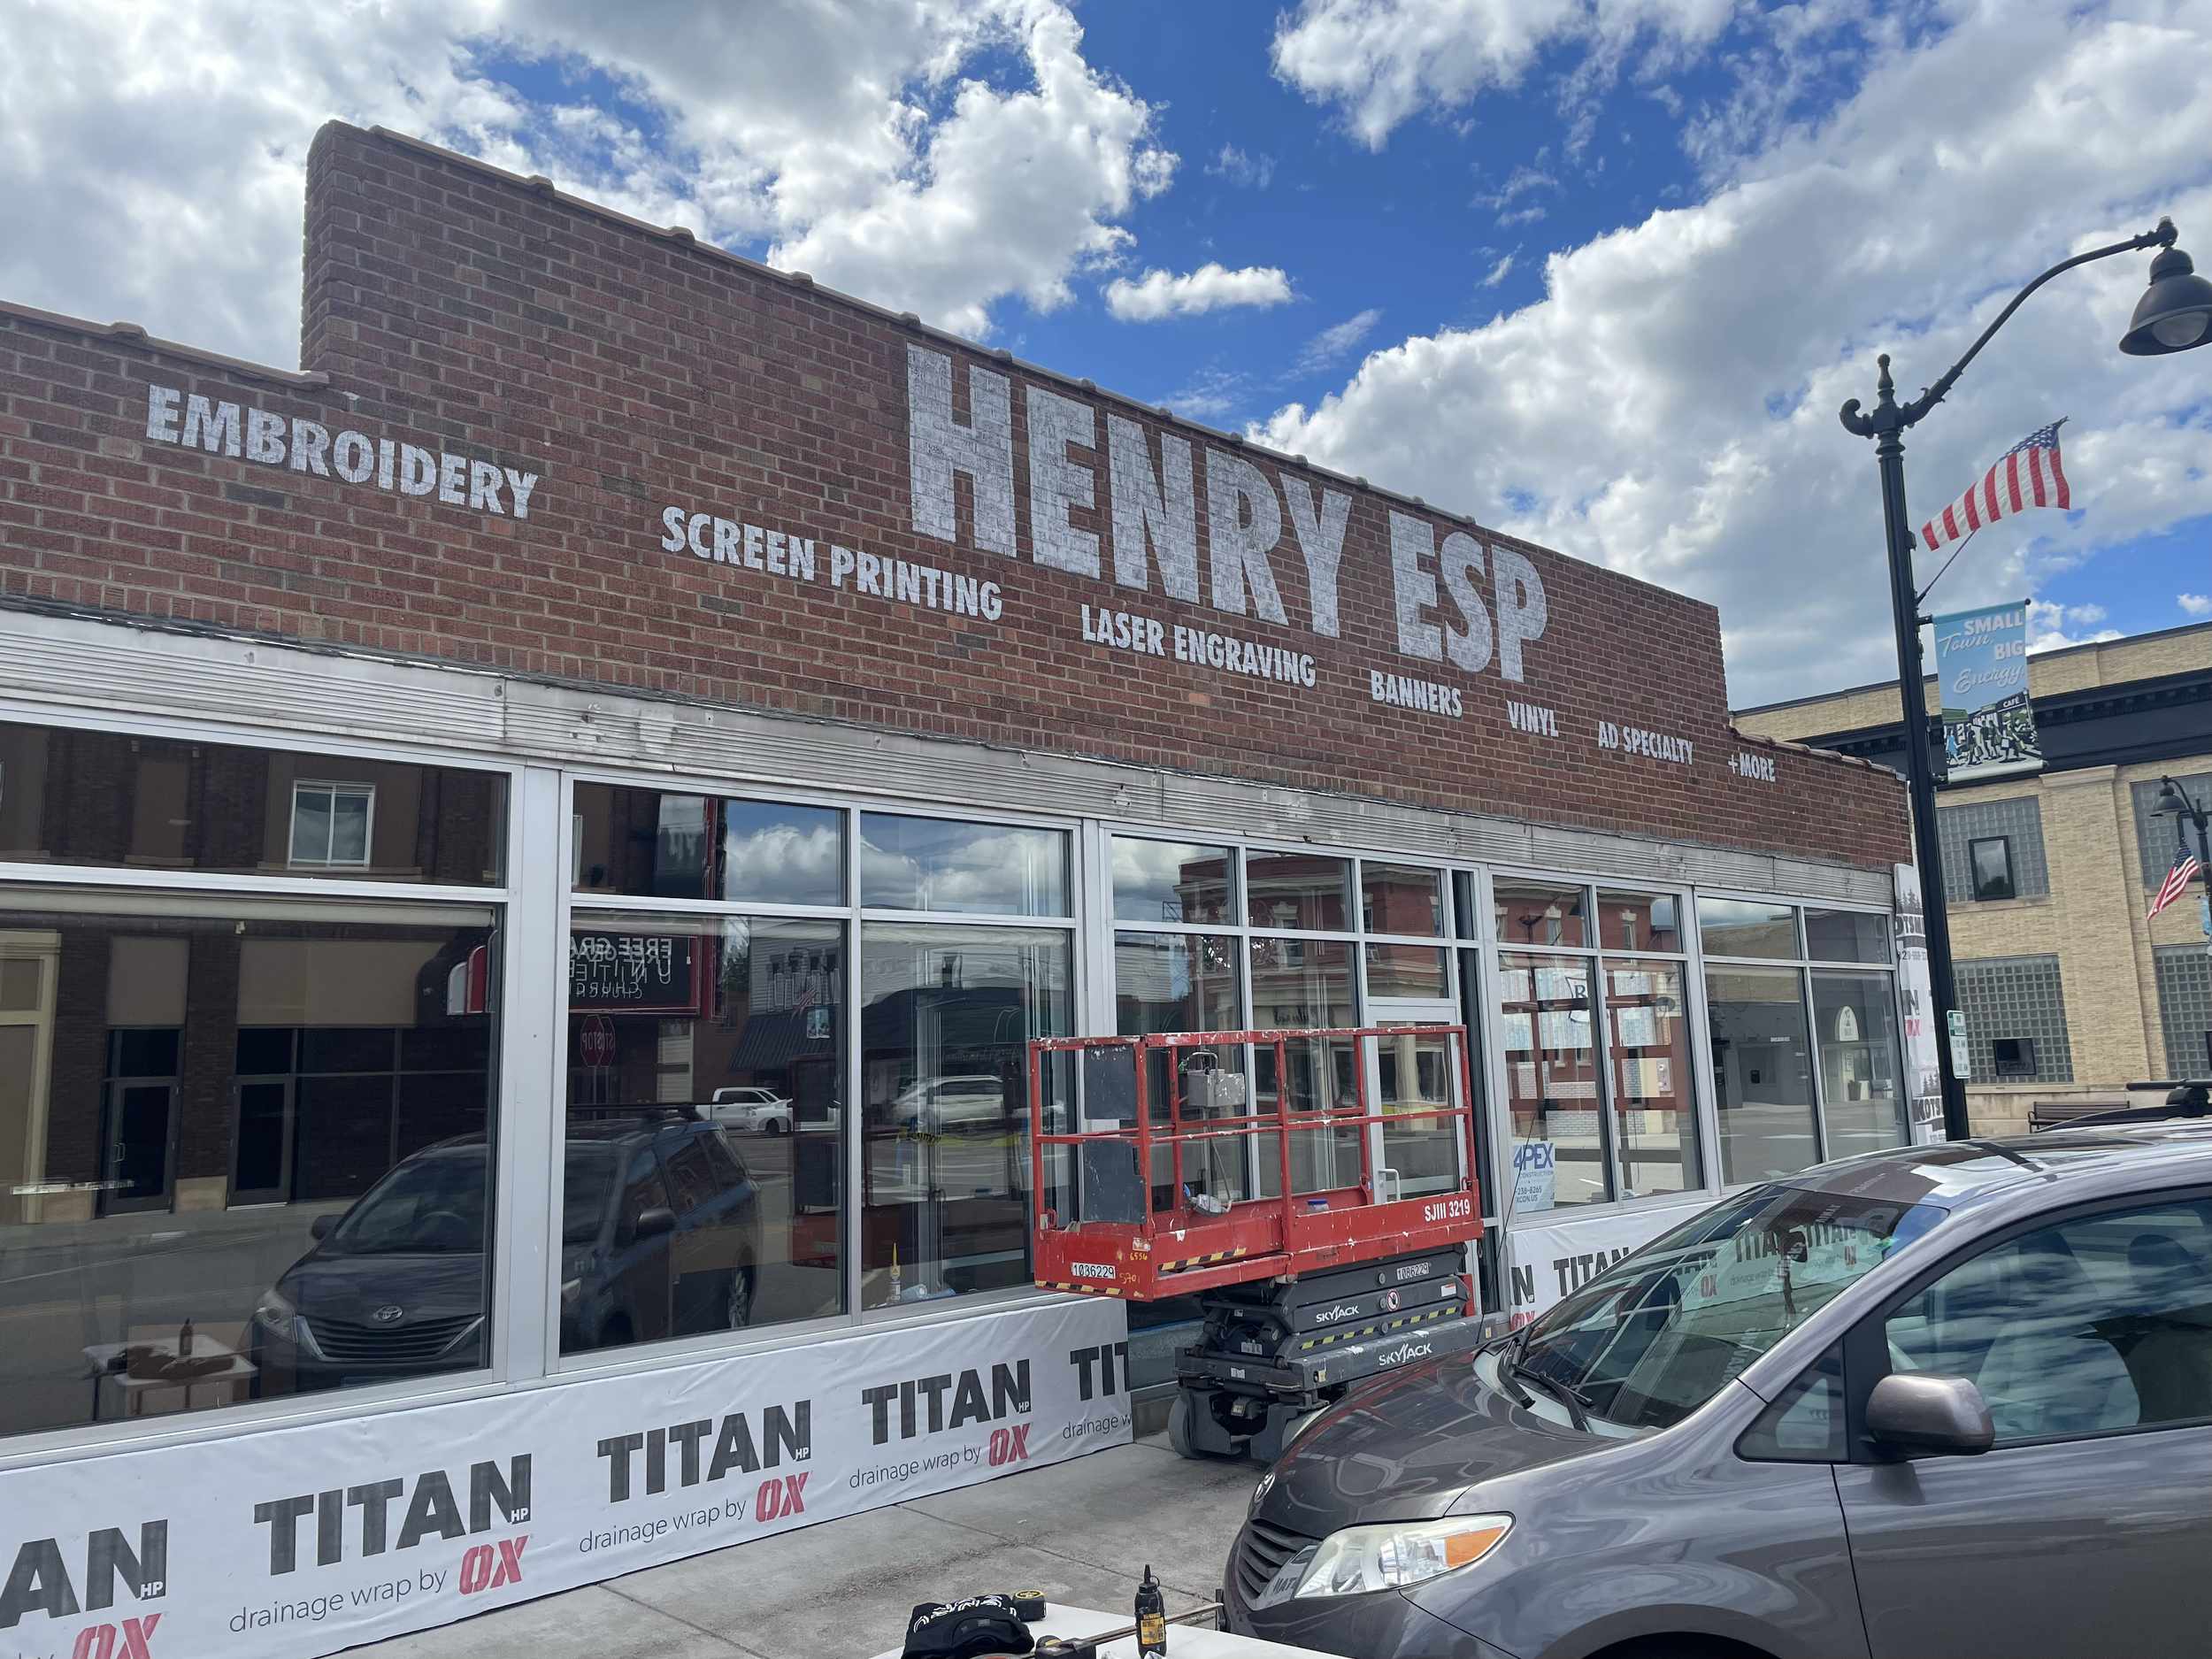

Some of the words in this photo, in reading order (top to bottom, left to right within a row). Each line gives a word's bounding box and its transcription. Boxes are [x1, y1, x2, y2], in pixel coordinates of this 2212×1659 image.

[145, 384, 539, 519] EMBROIDERY
[907, 342, 1352, 638] HENRY
[1389, 510, 1548, 682] ESP
[661, 507, 814, 580] SCREEN
[831, 544, 1002, 620] PRINTING
[1964, 611, 2023, 636] SMALL
[1080, 604, 1164, 657] LASER
[1174, 625, 1316, 687] ENGRAVING
[1994, 640, 2024, 661] BIG
[1371, 670, 1462, 718] BANNERS
[1953, 664, 2024, 694] Energy.
[2003, 696, 2020, 708] CAFÉ
[1507, 700, 1558, 737] VINYL
[1598, 721, 1618, 749] AD
[1623, 726, 1694, 764] SPECIALTY
[1513, 1143, 1554, 1170] APEX
[1448, 1198, 1471, 1217] 3219
[1398, 1263, 1428, 1279] 1086229
[1316, 1304, 1360, 1323] SKYJACK
[1379, 1342, 1432, 1366] SKYJACK
[862, 1359, 1032, 1446] TITAN
[1018, 1402, 1030, 1413] HP
[1063, 1416, 1118, 1440] drainage
[597, 1400, 811, 1503] TITAN
[795, 1447, 810, 1460] HP
[849, 1460, 919, 1488] drainage
[923, 1450, 960, 1470] wrap
[964, 1445, 981, 1463] by
[988, 1423, 1031, 1467] OX
[254, 1453, 532, 1577] TITAN
[511, 1507, 529, 1523] HP
[579, 1519, 668, 1553] drainage
[672, 1506, 720, 1527] wrap
[726, 1499, 747, 1520] by
[756, 1471, 810, 1523] OX
[140, 1581, 164, 1598] HP
[229, 1593, 344, 1632] drainage
[350, 1578, 412, 1607] wrap
[419, 1568, 448, 1594] by
[458, 1535, 529, 1595] OX
